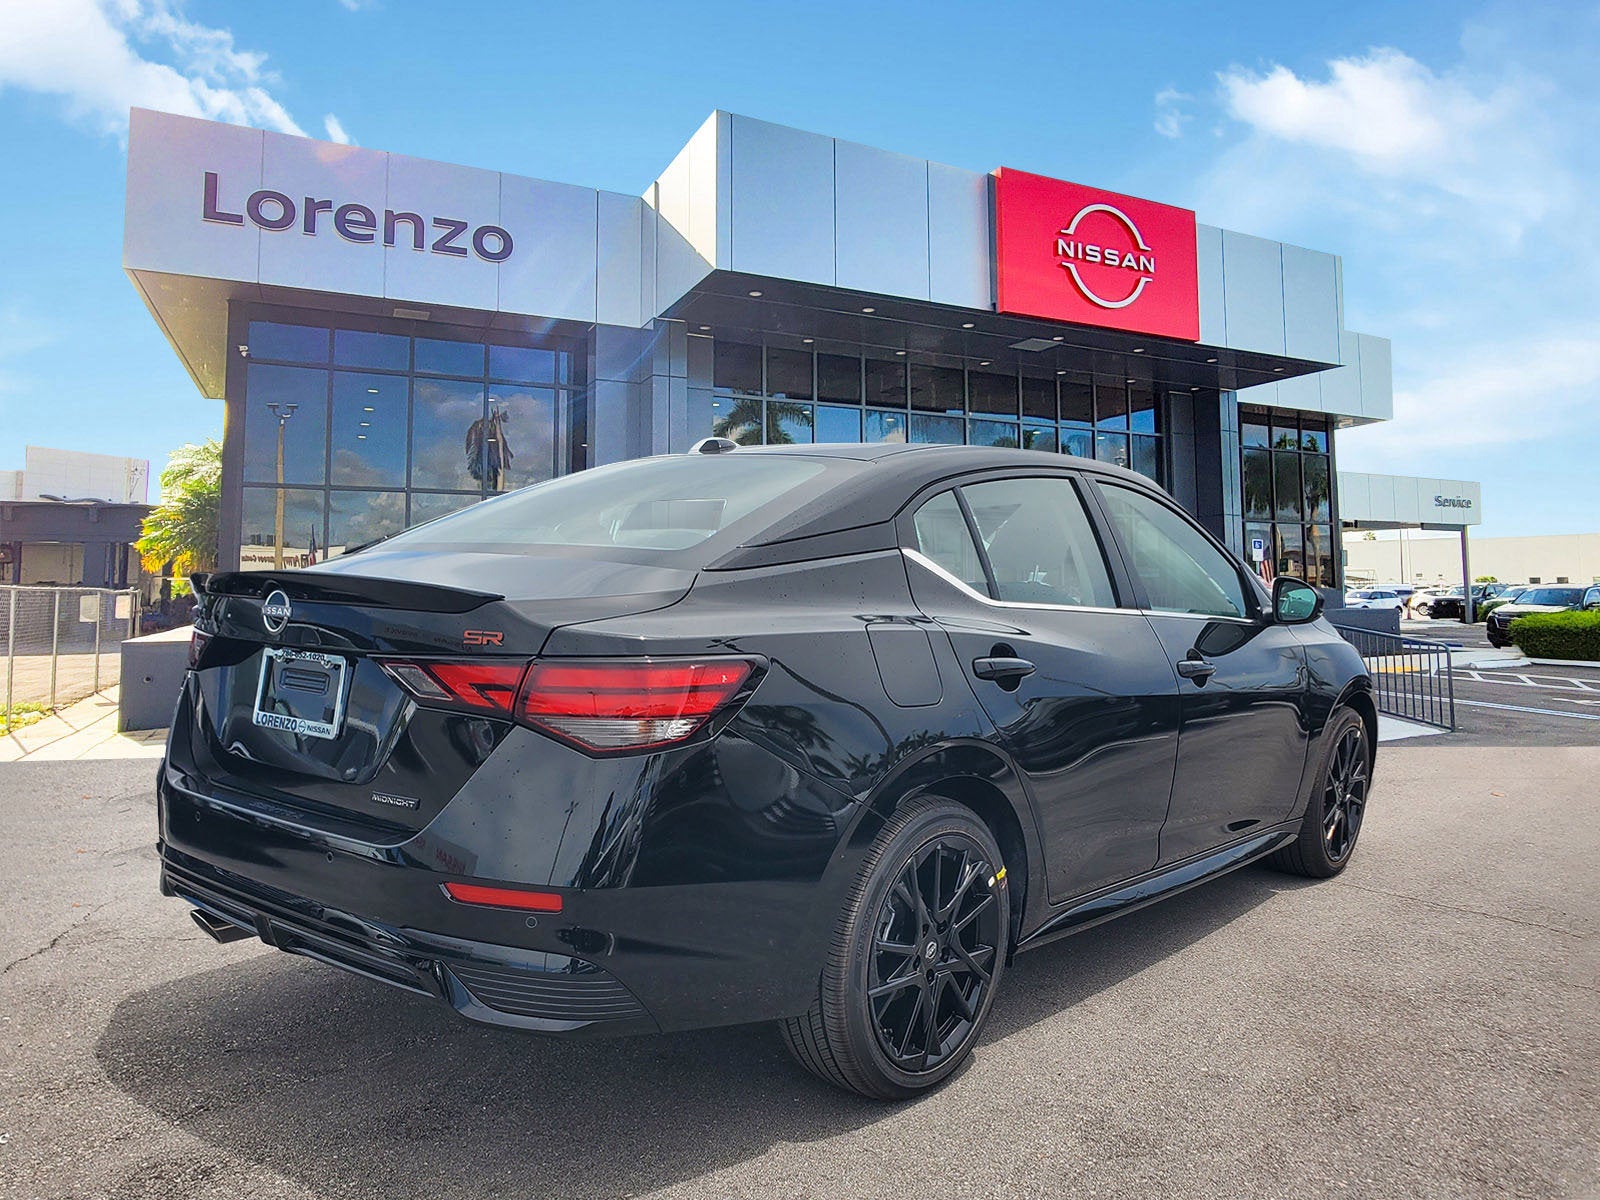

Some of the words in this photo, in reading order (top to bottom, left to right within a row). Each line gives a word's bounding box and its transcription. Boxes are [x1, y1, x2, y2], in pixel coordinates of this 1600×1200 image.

[202, 171, 514, 263] Lorenzo
[1057, 238, 1155, 273] NISSAN
[1434, 495, 1472, 509] Service
[463, 629, 503, 646] SR
[256, 712, 298, 732] LORENZO
[306, 724, 332, 736] NISSAN
[371, 793, 416, 808] MIDNIGHT
